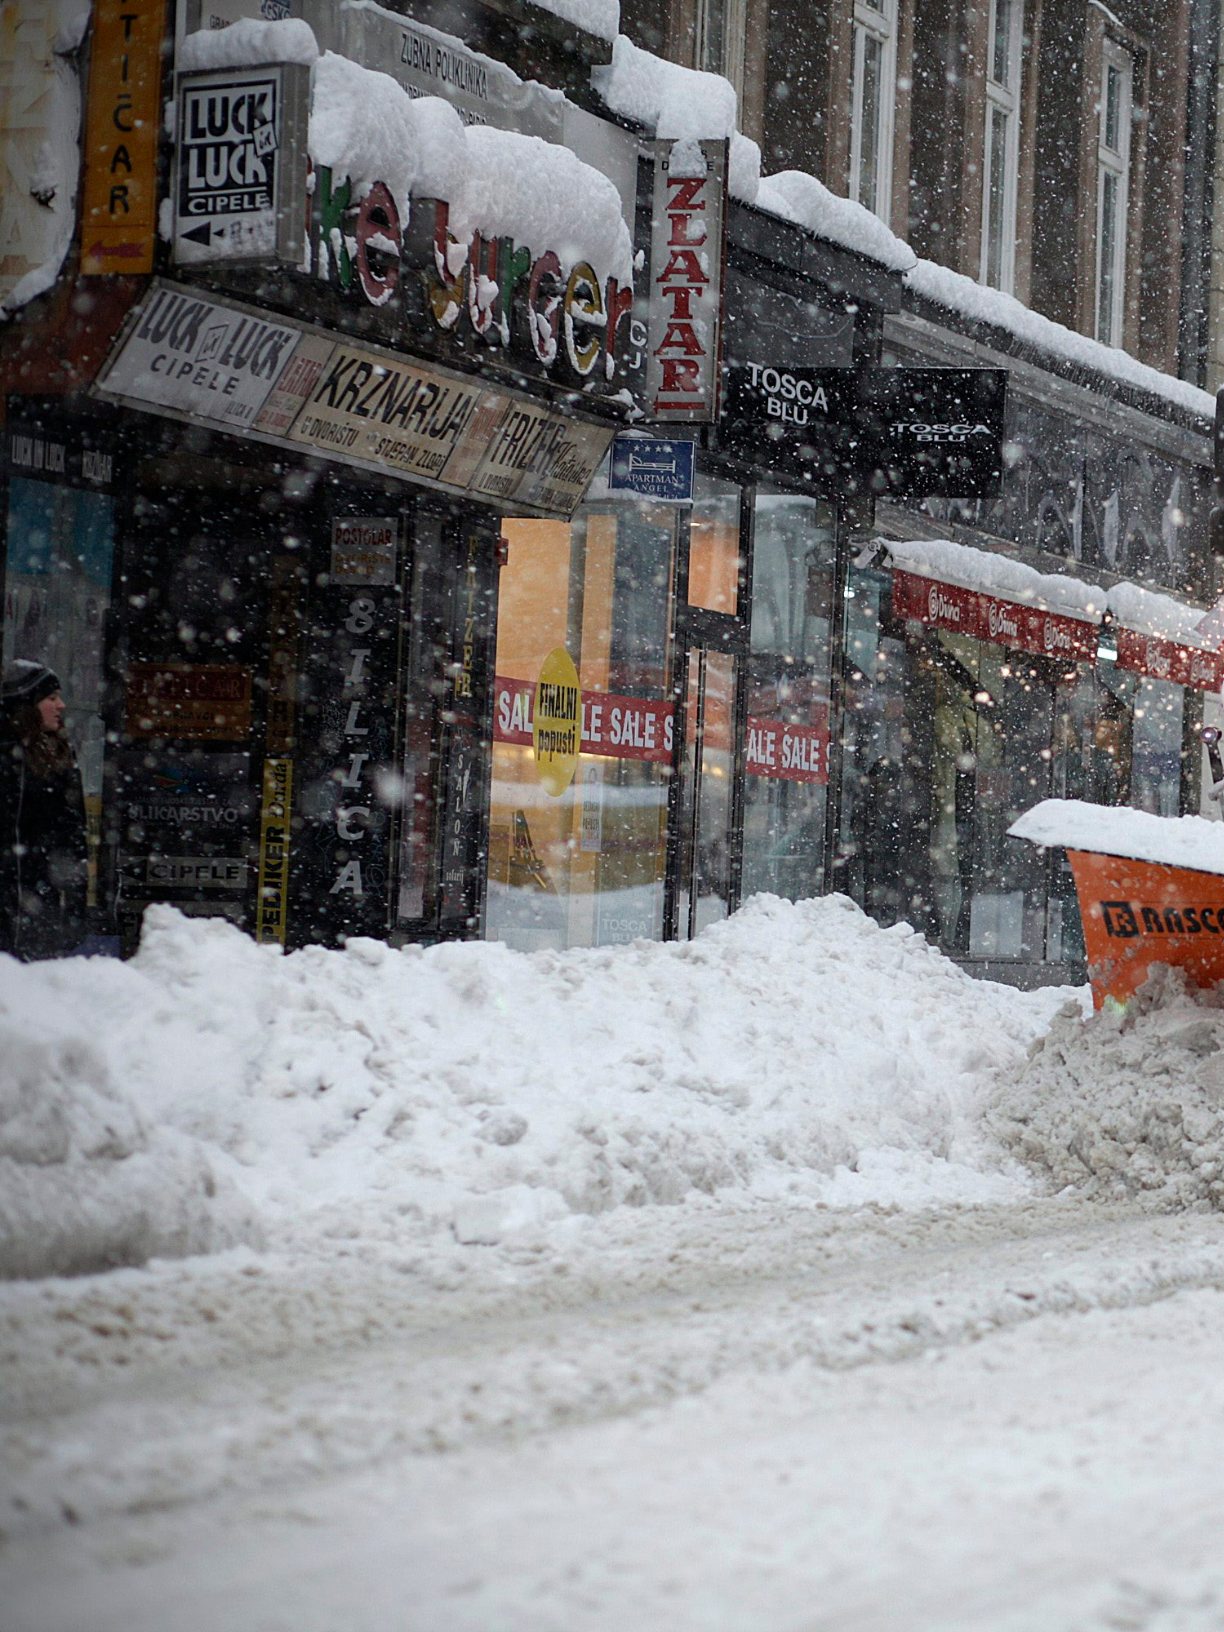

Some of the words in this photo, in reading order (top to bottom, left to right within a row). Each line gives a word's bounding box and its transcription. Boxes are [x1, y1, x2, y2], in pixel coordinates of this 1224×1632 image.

[401, 32, 432, 75] ZUBNA
[435, 47, 488, 101] POLIKLINIKA
[109, 13, 138, 214] TIČAR
[190, 91, 268, 139] LUCK
[188, 143, 268, 189] LUCK
[188, 192, 271, 214] CIPELE
[656, 177, 710, 393] ZLATAR
[136, 290, 213, 354] LUCK
[218, 318, 293, 381] LUCK
[151, 354, 240, 396] CIPELE
[747, 361, 829, 414] TOSCA
[314, 355, 473, 444] KRZNARIJA
[767, 396, 808, 425] BLU
[309, 417, 359, 447] DVORIŠTU
[490, 411, 567, 474] FRIZER
[891, 423, 992, 434] TOSCA
[916, 434, 966, 442] BLU
[624, 473, 679, 484] APARTMAN
[634, 484, 668, 493] ANGEL
[335, 527, 392, 546] POSTOLAR
[498, 690, 534, 734] SAL
[580, 704, 603, 743] LE
[610, 708, 656, 749] SALE
[540, 683, 578, 721] FINALNI
[538, 726, 576, 763] popusti
[747, 730, 776, 766] ALE
[782, 734, 820, 773] SALE
[150, 864, 240, 881] CIPELE
[262, 825, 285, 942] PEDIKER
